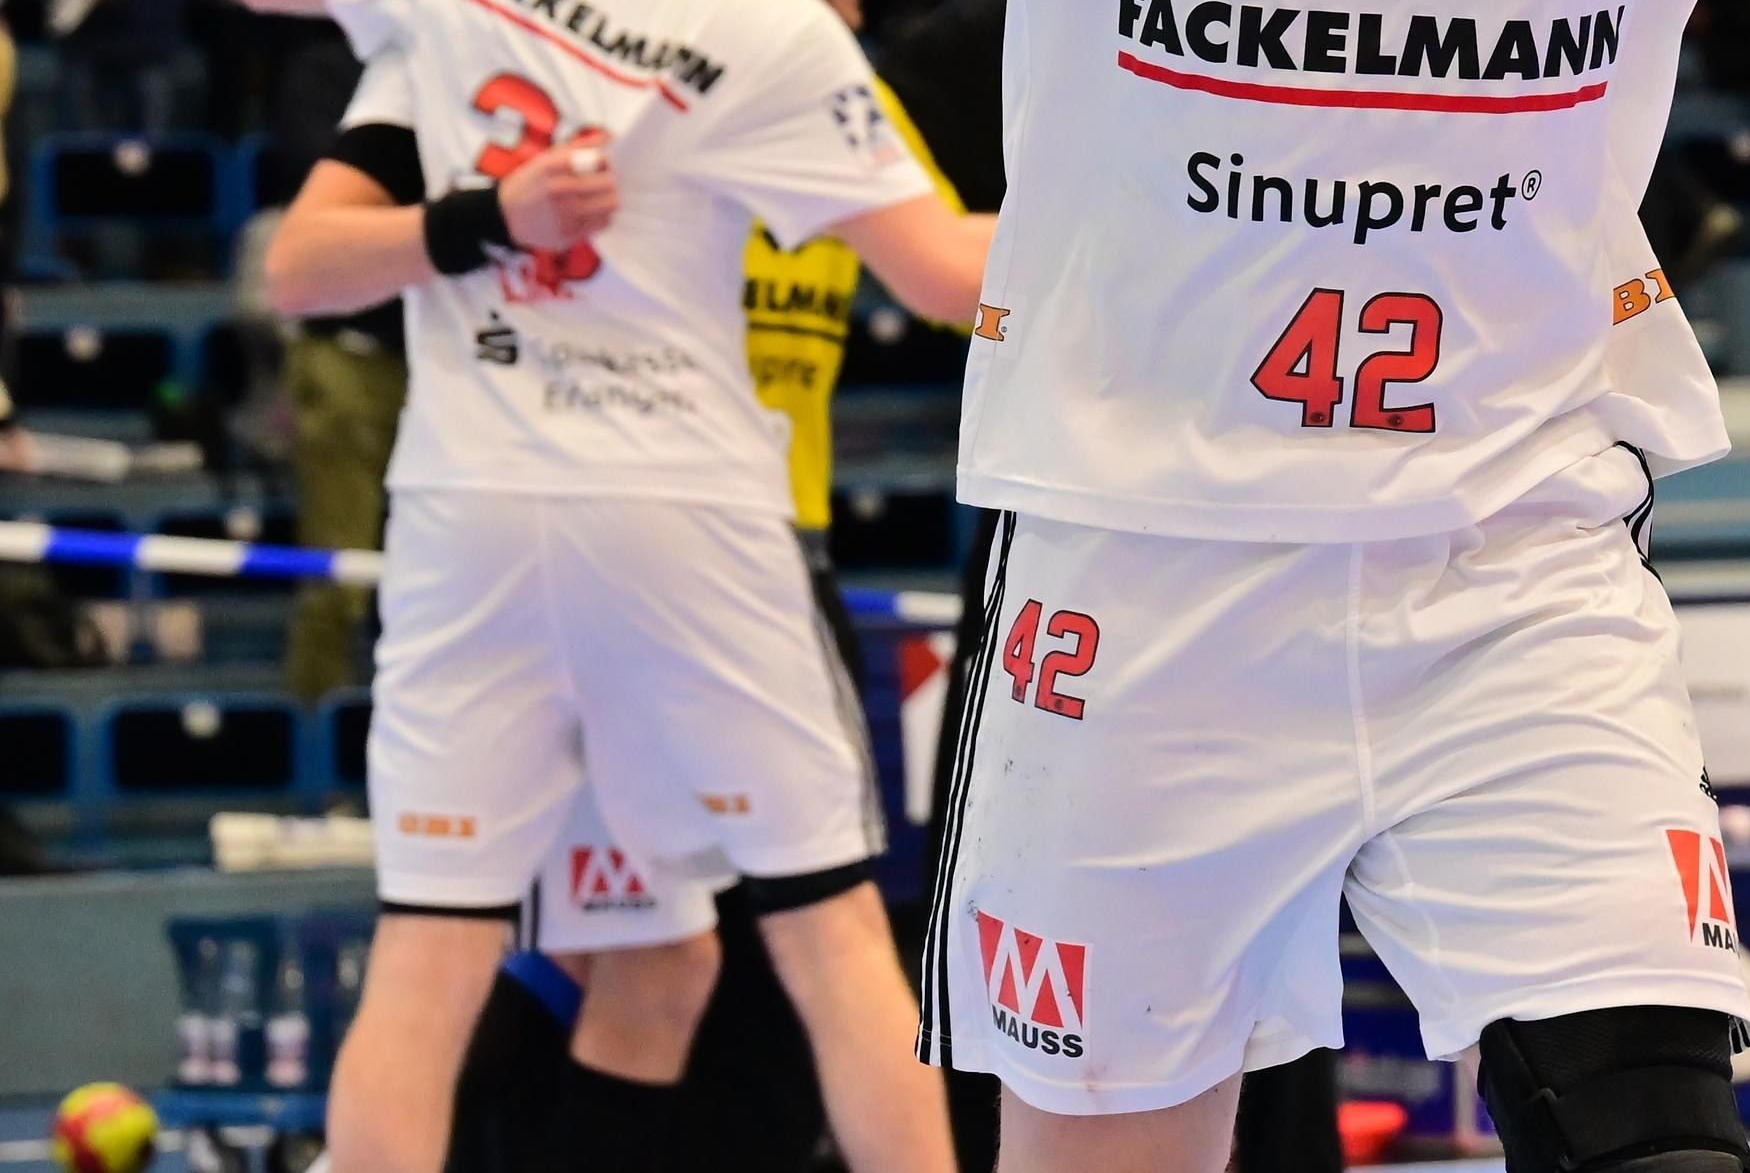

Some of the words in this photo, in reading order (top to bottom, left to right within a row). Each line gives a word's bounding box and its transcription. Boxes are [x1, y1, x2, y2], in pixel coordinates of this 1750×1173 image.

[1249, 286, 1445, 434] 42
[1002, 598, 1101, 721] 42
[991, 1003, 1085, 1058] MAUSS
